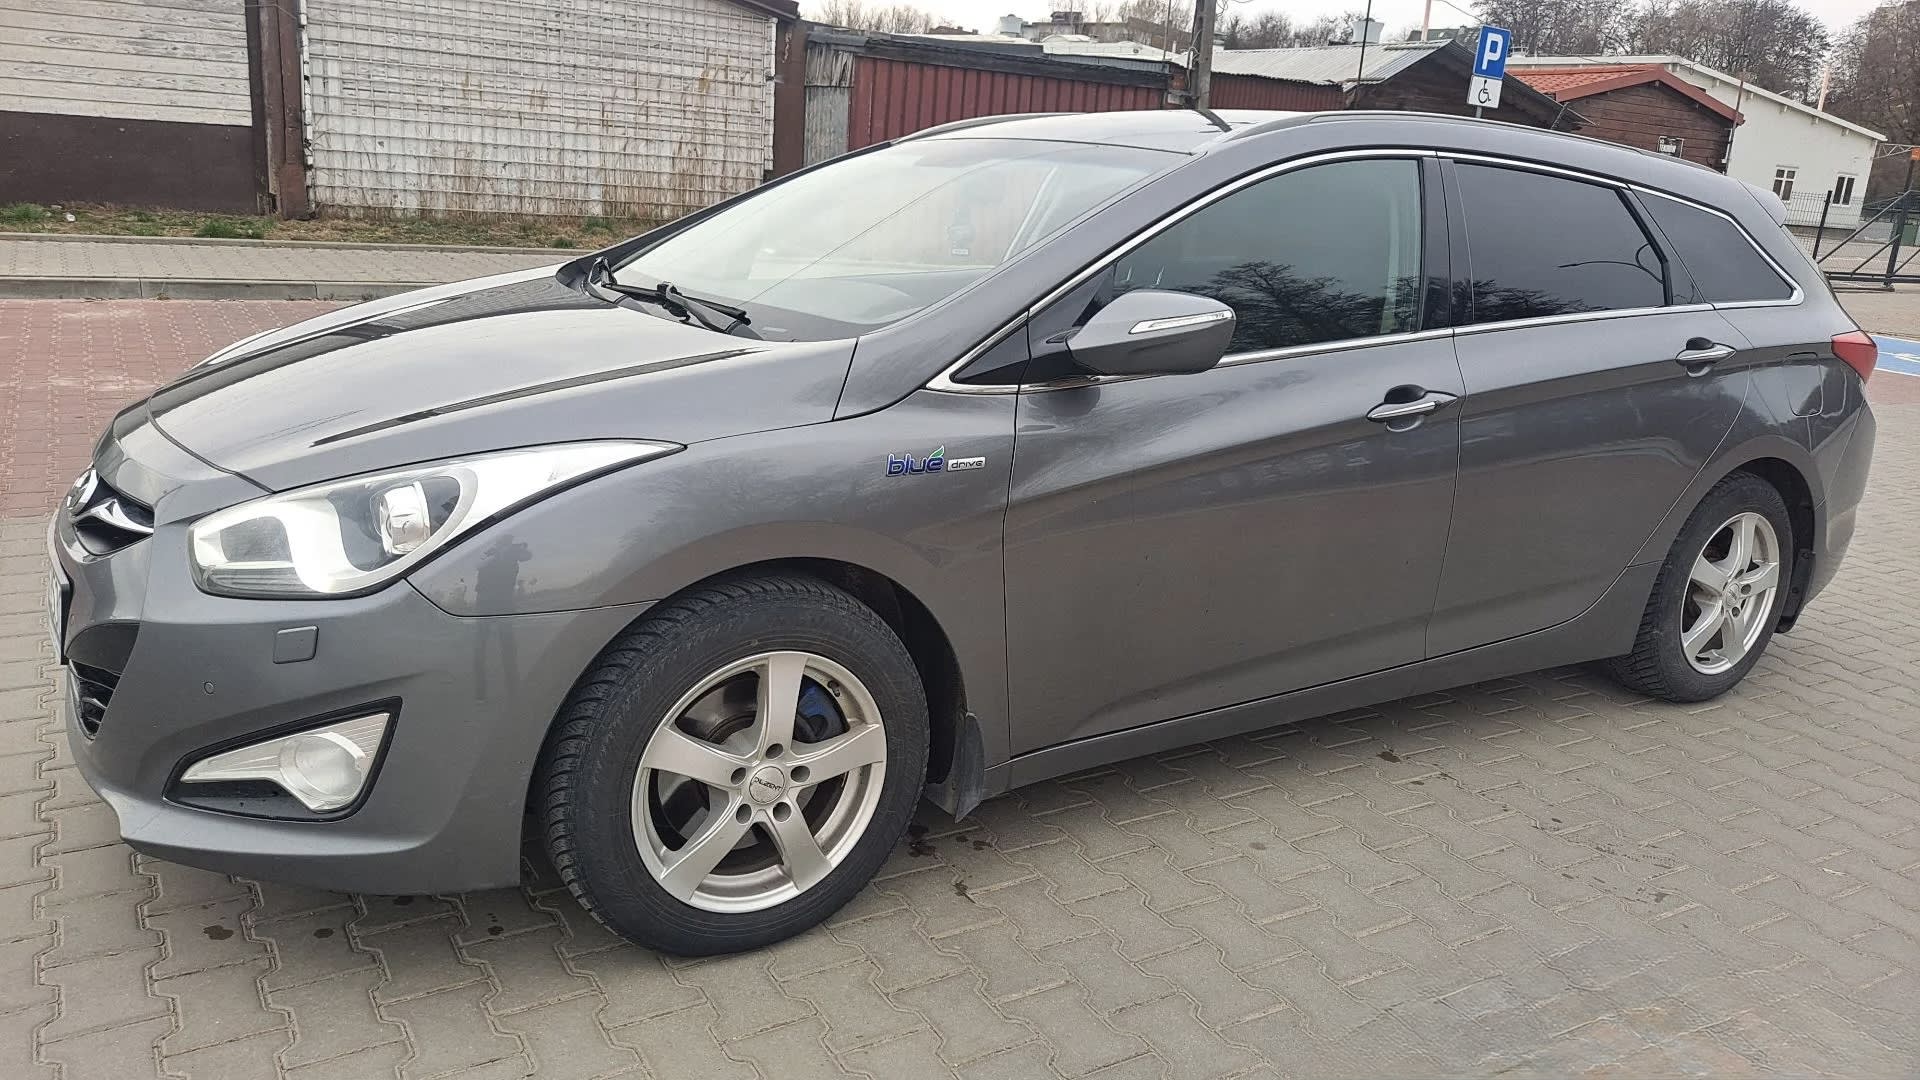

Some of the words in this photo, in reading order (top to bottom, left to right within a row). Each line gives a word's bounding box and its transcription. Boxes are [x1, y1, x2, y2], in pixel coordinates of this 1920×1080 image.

[1482, 32, 1503, 70] P
[887, 452, 944, 475] blue
[950, 459, 984, 470] drive
